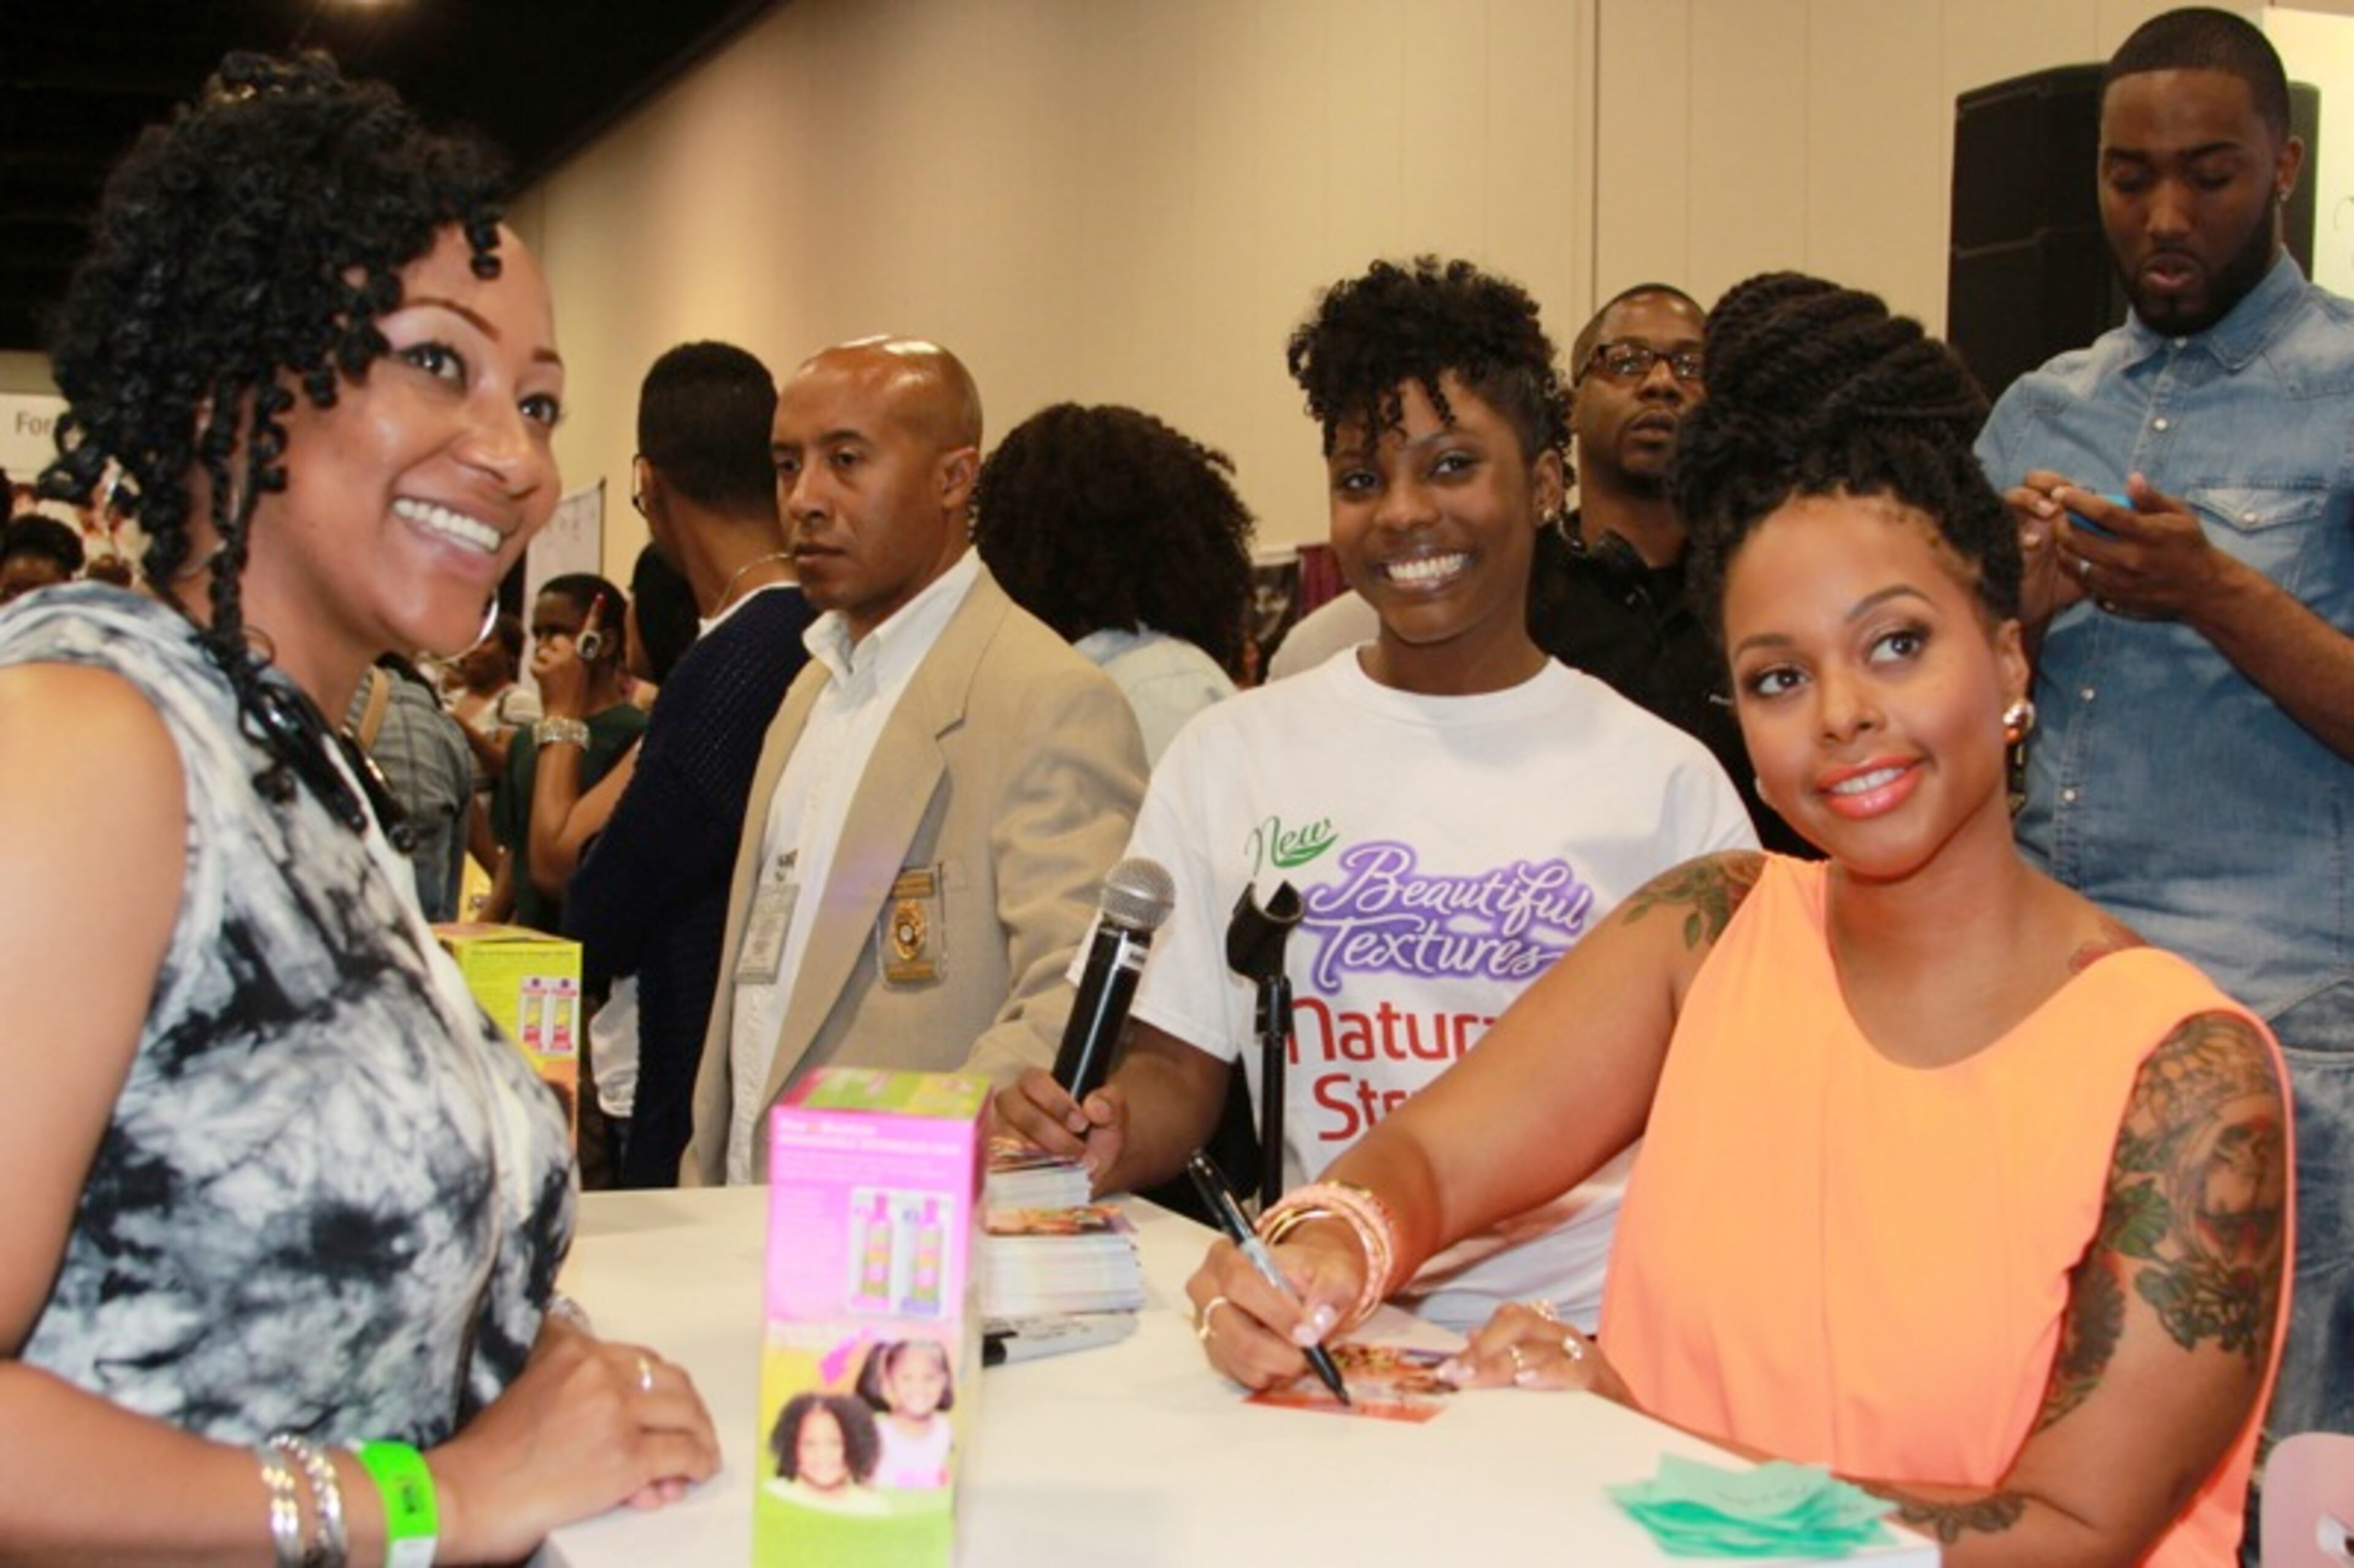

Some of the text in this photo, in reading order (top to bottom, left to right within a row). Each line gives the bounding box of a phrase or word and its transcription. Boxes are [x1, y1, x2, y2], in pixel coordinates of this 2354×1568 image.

[1244, 815, 1339, 877] New
[1308, 846, 1589, 937] Beautiful
[1303, 913, 1565, 988] Textures
